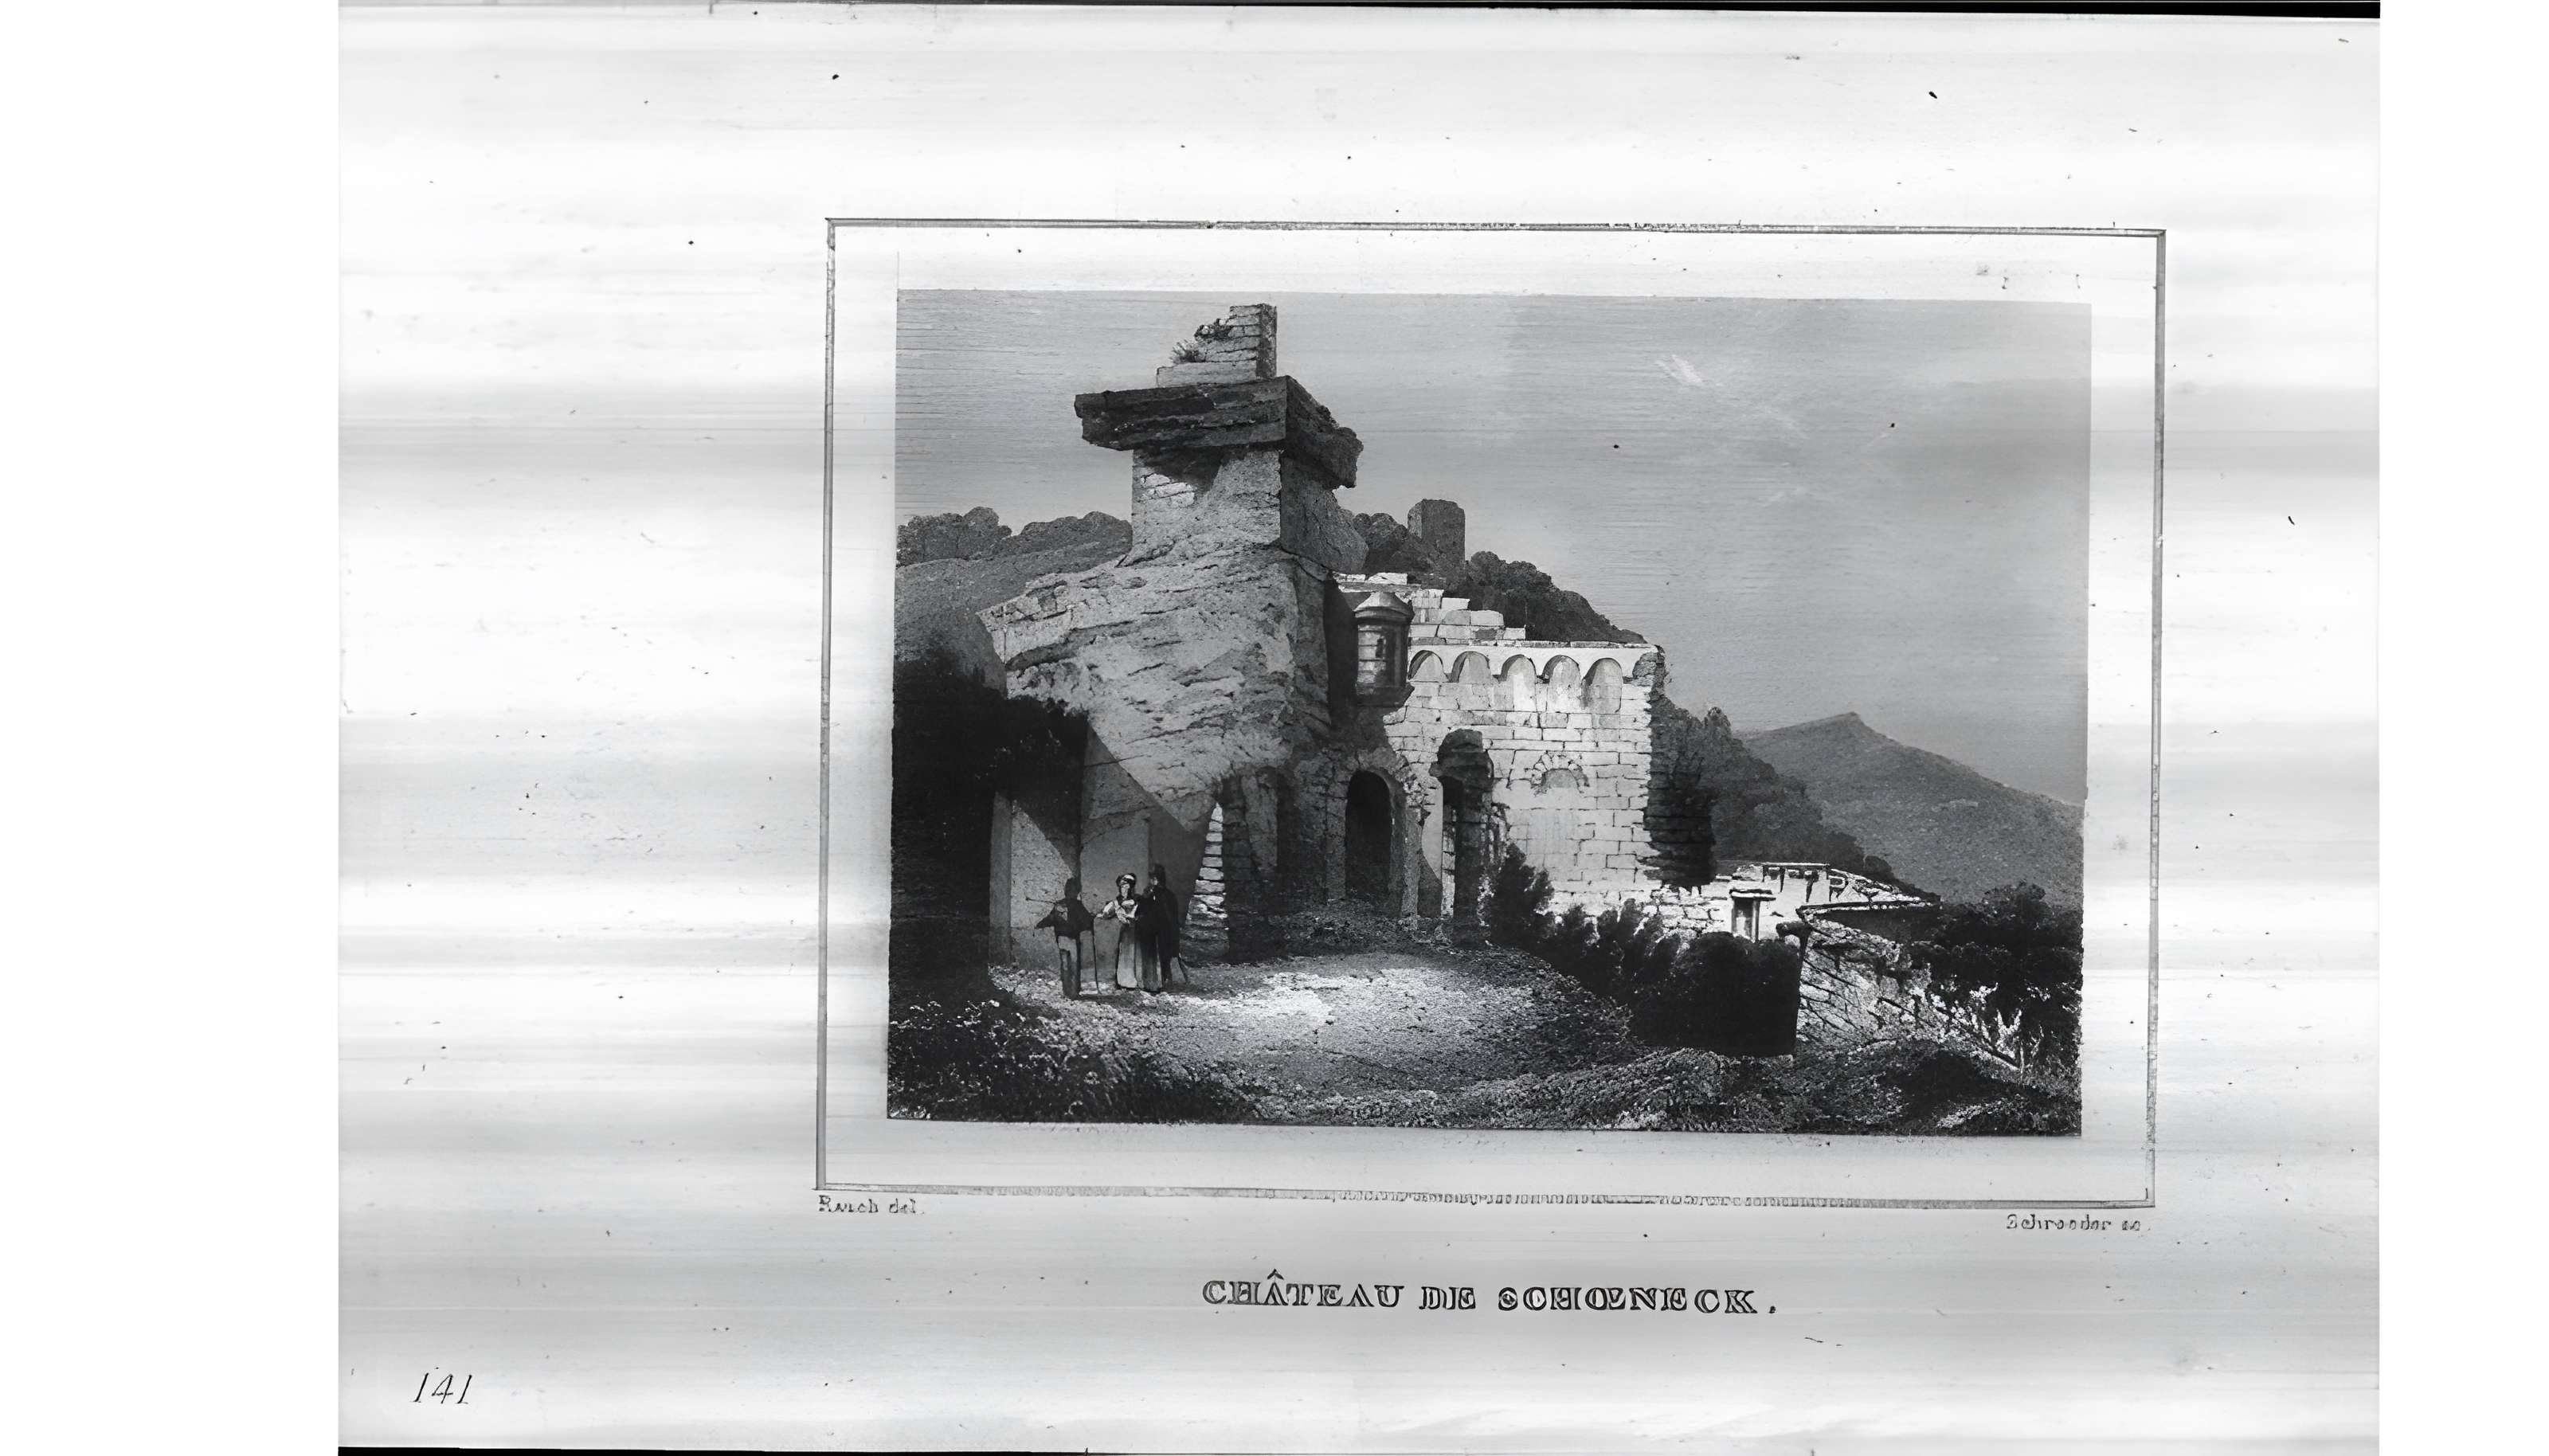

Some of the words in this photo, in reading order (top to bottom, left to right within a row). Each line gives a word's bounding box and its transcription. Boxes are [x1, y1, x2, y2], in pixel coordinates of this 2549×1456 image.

[1202, 1268, 1404, 1308] CHÂTEAU
[1418, 1286, 1476, 1310] DE
[413, 1372, 472, 1404] 141
